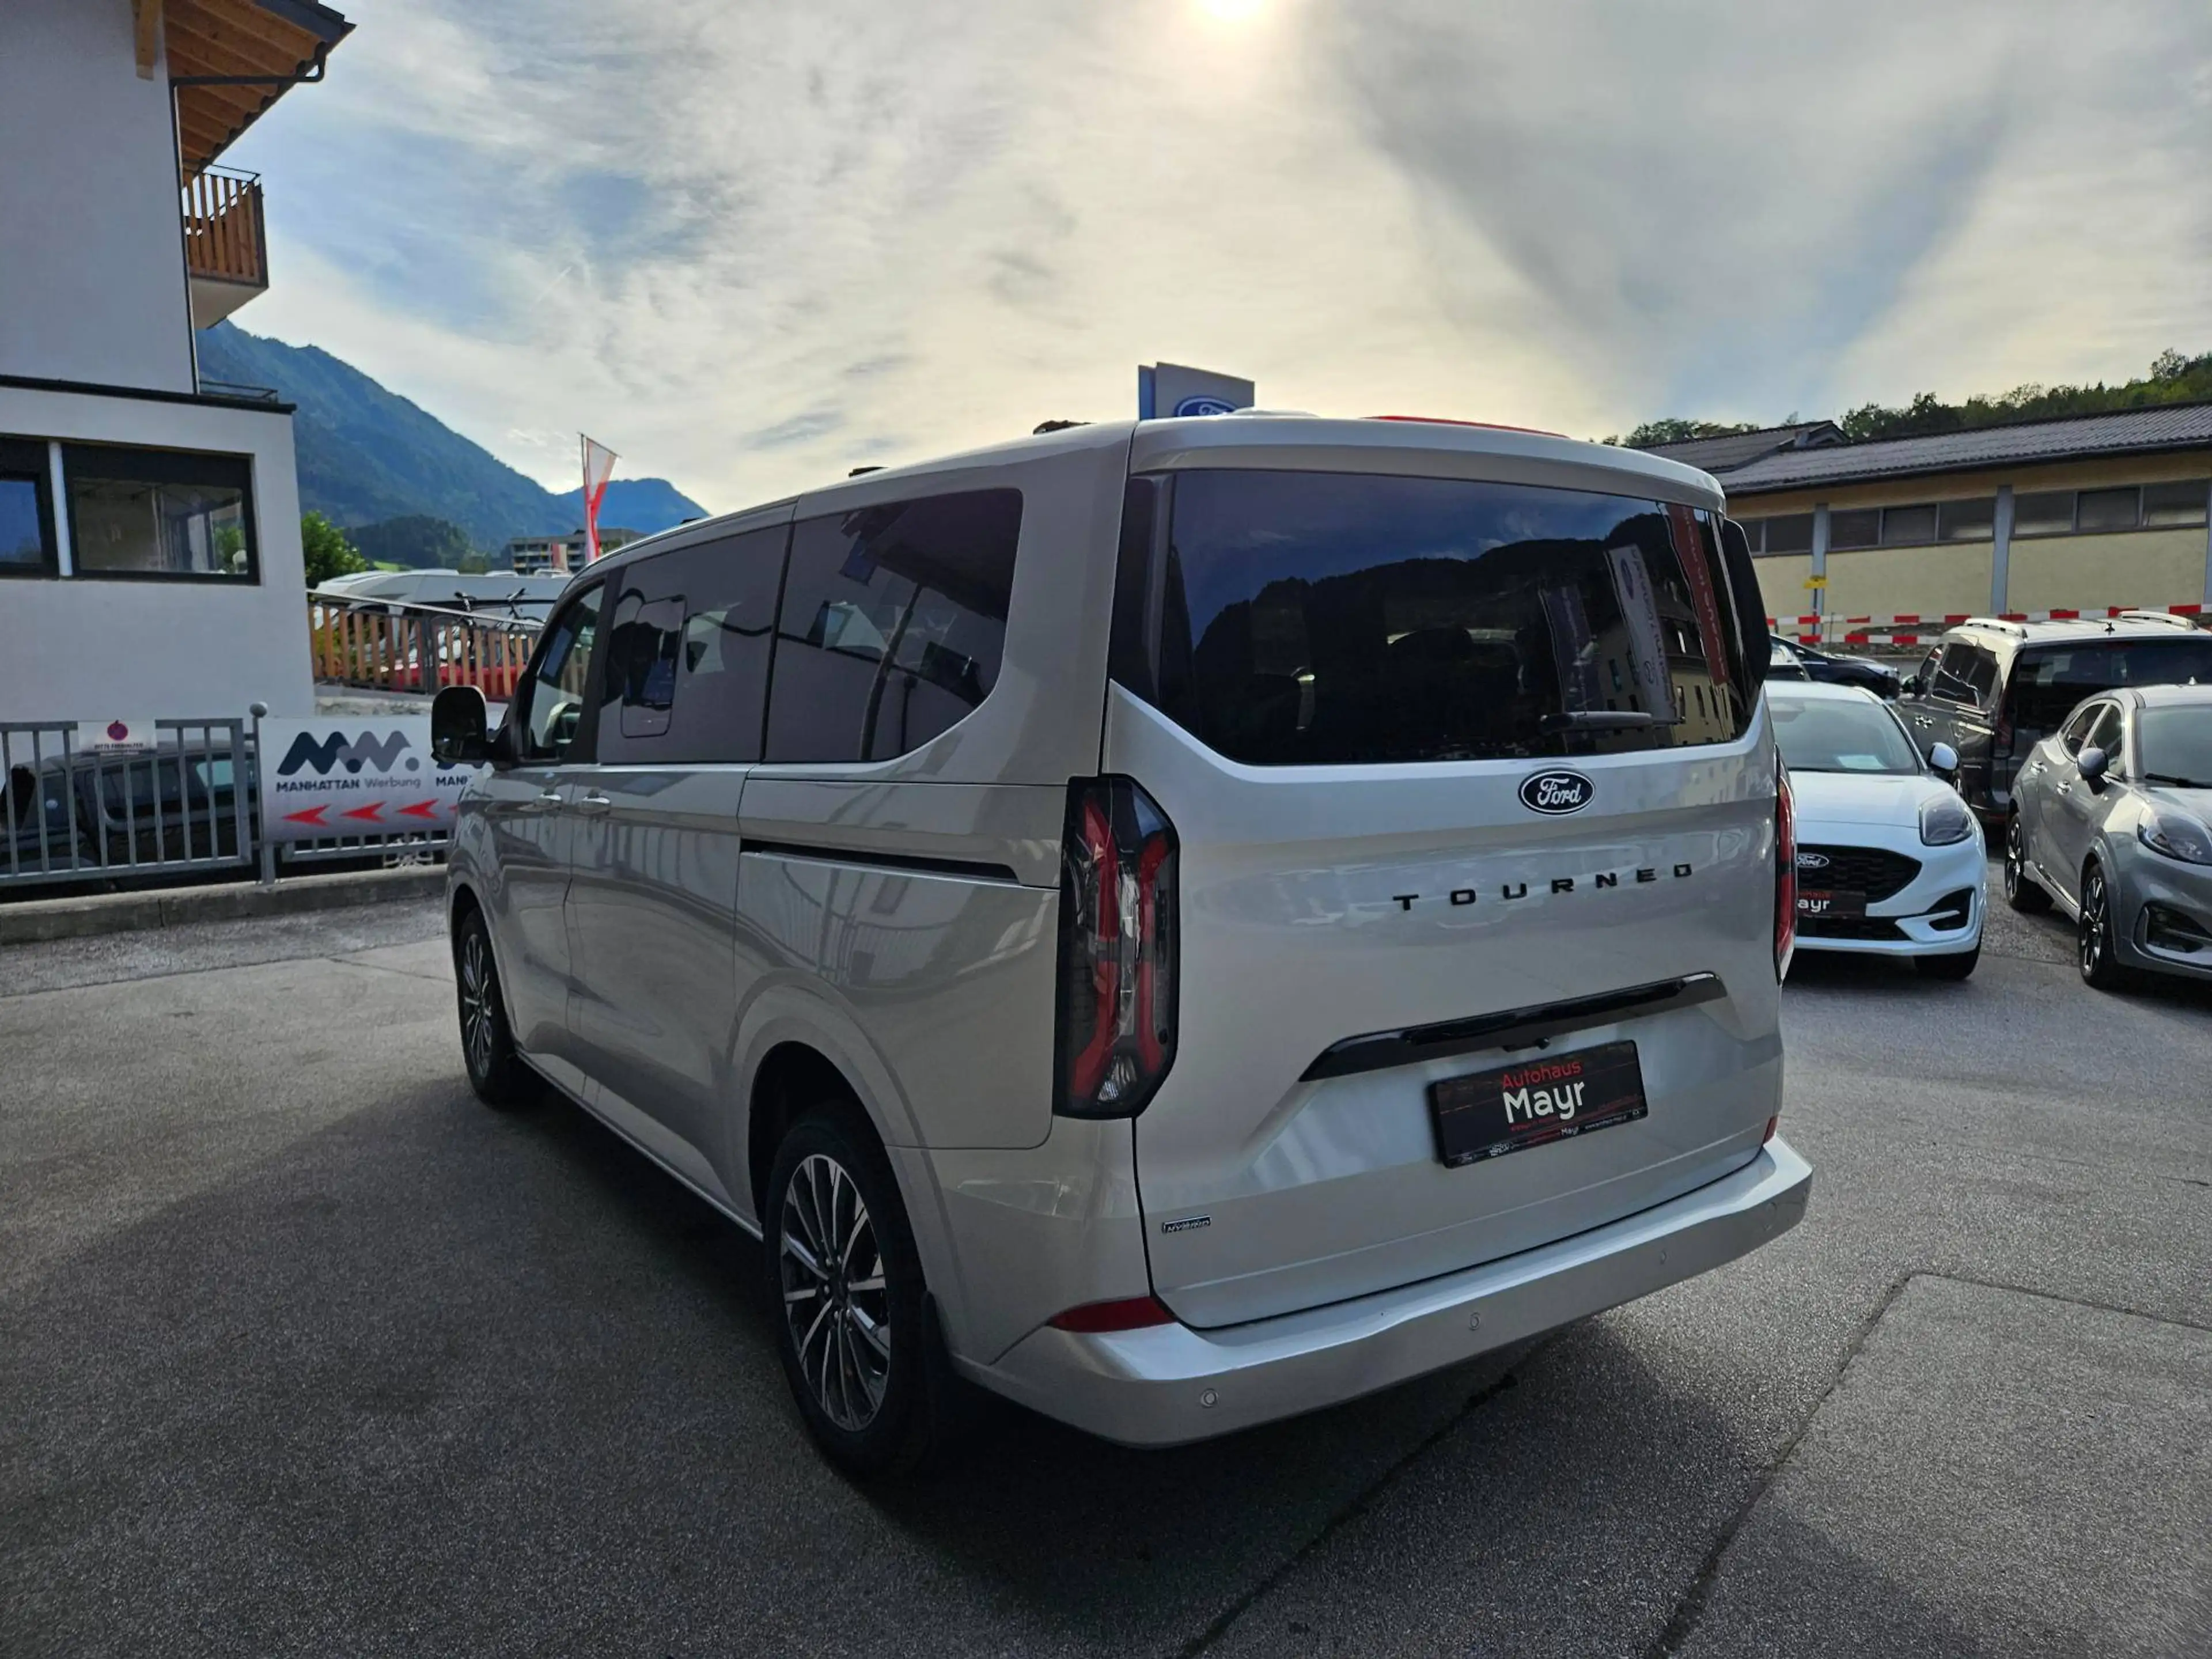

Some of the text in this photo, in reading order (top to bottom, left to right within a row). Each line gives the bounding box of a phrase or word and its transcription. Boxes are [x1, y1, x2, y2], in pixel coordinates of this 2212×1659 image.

[276, 776, 421, 793] MANHATTAN Werbung
[435, 775, 468, 787] MANH
[1537, 778, 1582, 806] Ford
[1392, 863, 1692, 911] TOURNEO
[1797, 899, 1830, 912] ayr
[1502, 1060, 1583, 1089] Autohaus
[1502, 1081, 1585, 1124] Mayr
